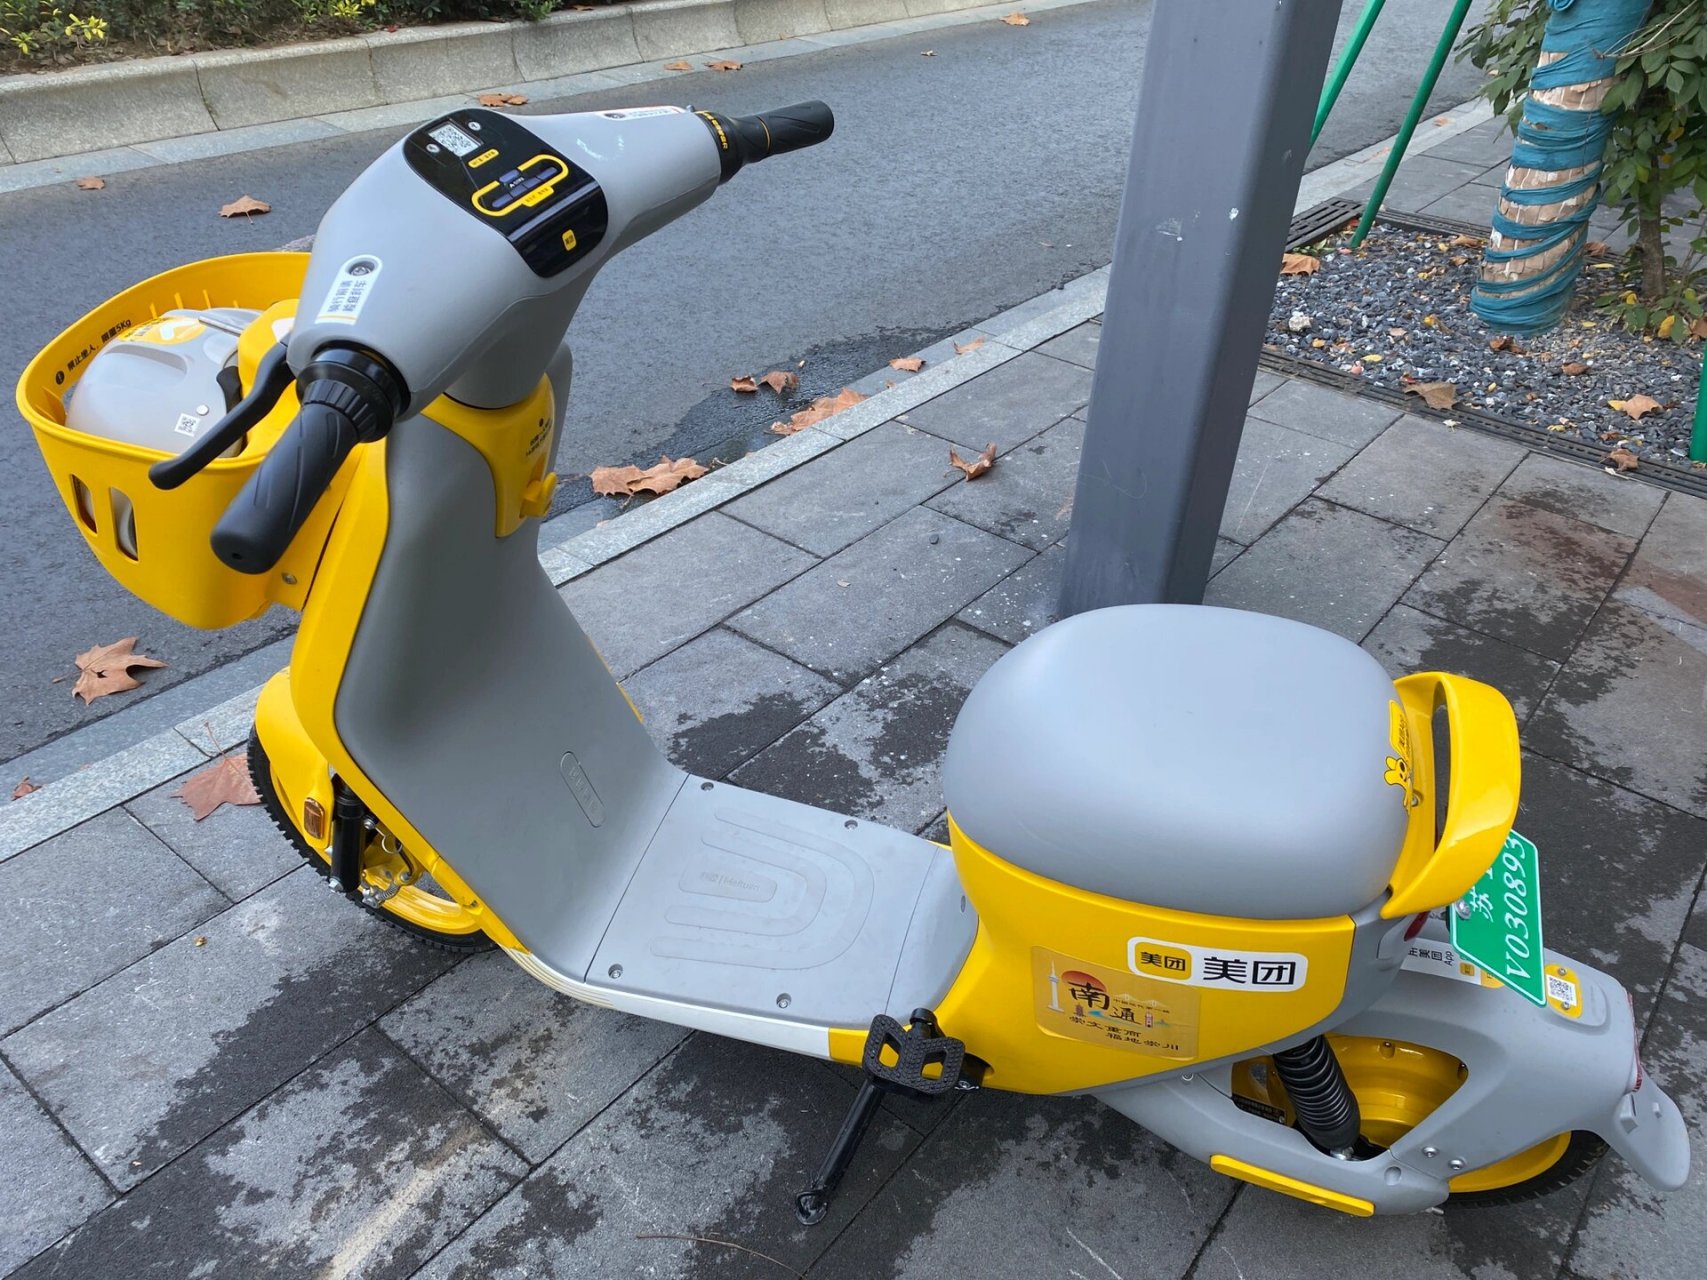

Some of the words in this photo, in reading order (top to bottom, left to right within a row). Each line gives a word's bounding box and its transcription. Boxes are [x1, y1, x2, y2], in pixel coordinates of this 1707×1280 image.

[1502, 837, 1531, 979] V030893
[1140, 951, 1186, 971] 美团
[1203, 956, 1296, 985] 美团
[1067, 981, 1142, 1026] 南通
